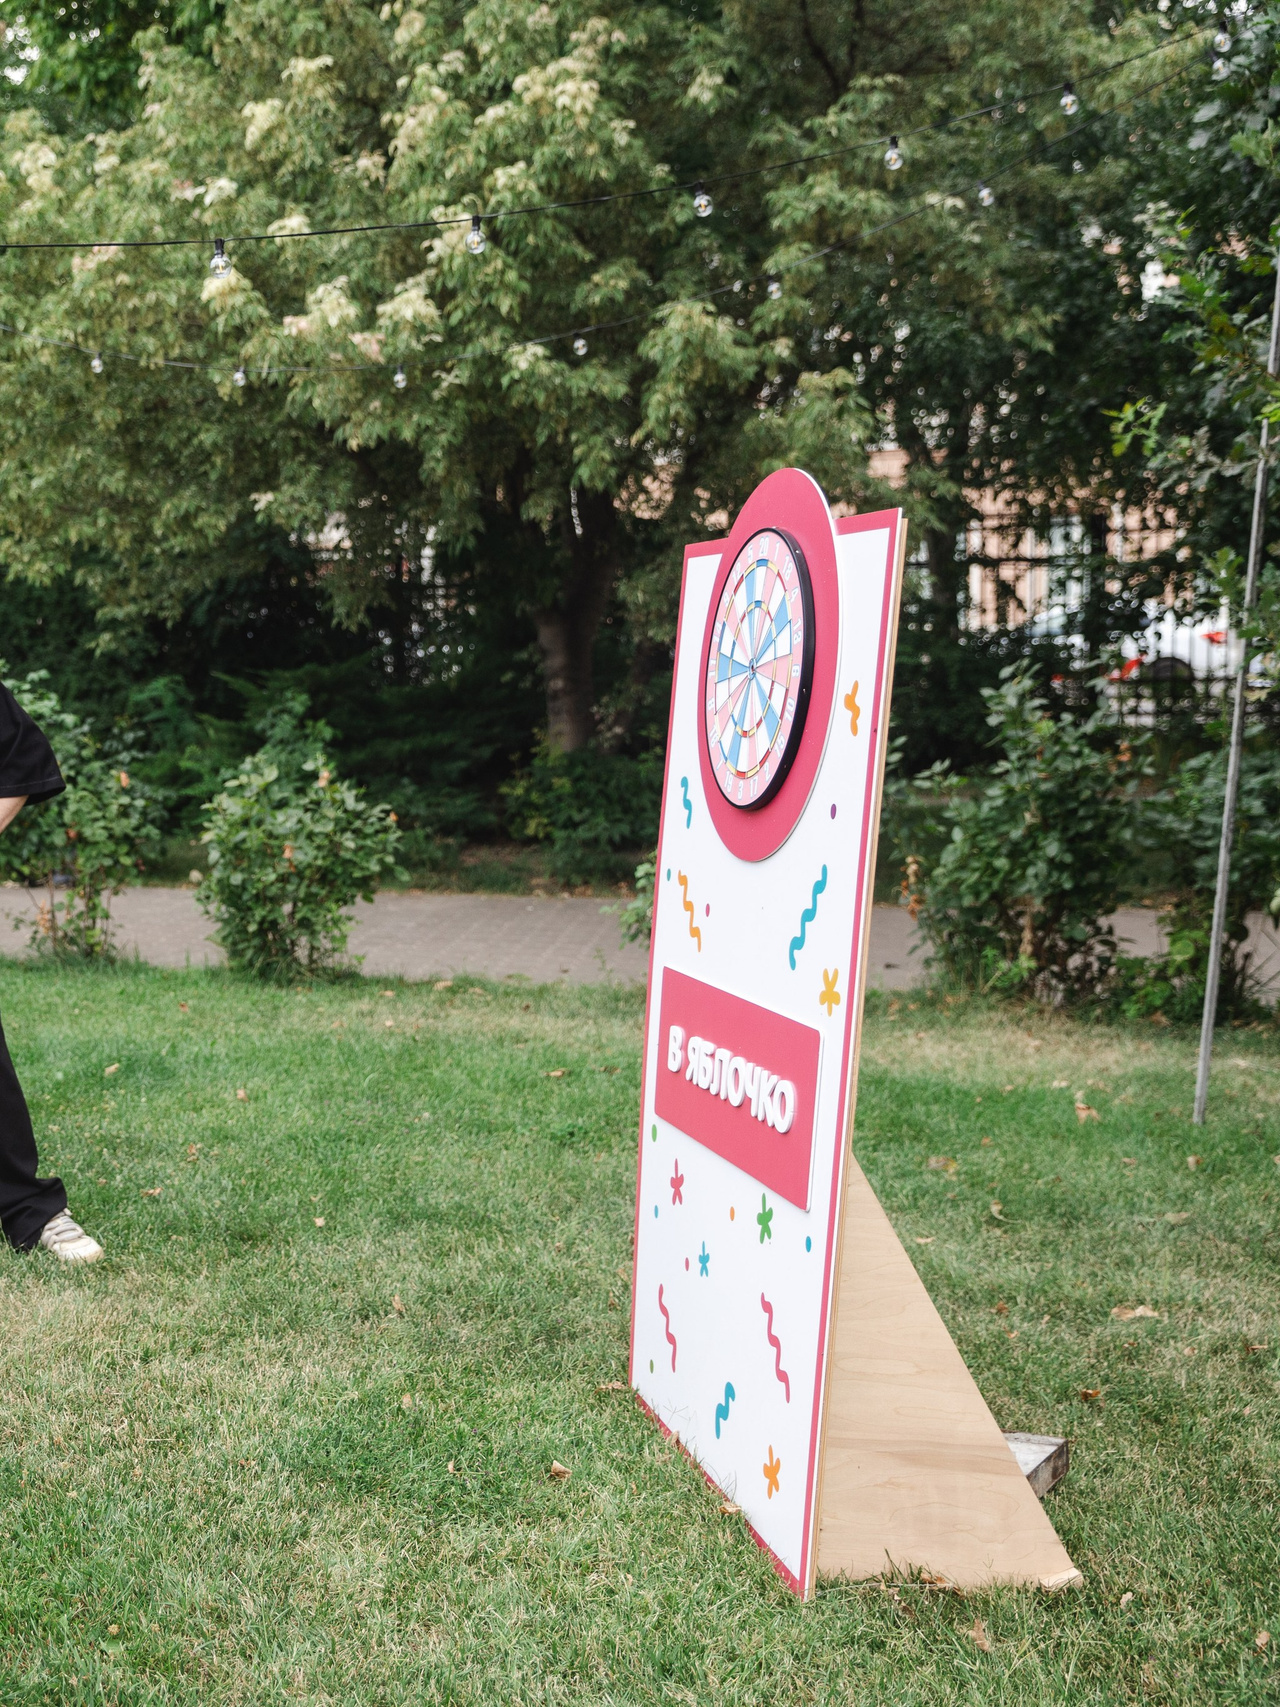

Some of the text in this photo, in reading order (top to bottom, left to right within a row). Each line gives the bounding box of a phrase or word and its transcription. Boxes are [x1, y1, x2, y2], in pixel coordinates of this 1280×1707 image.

[747, 543, 754, 564] 5
[759, 535, 770, 557] 20
[750, 775, 759, 800] 17
[667, 1025, 796, 1134] В ЯБЛОЧКО
